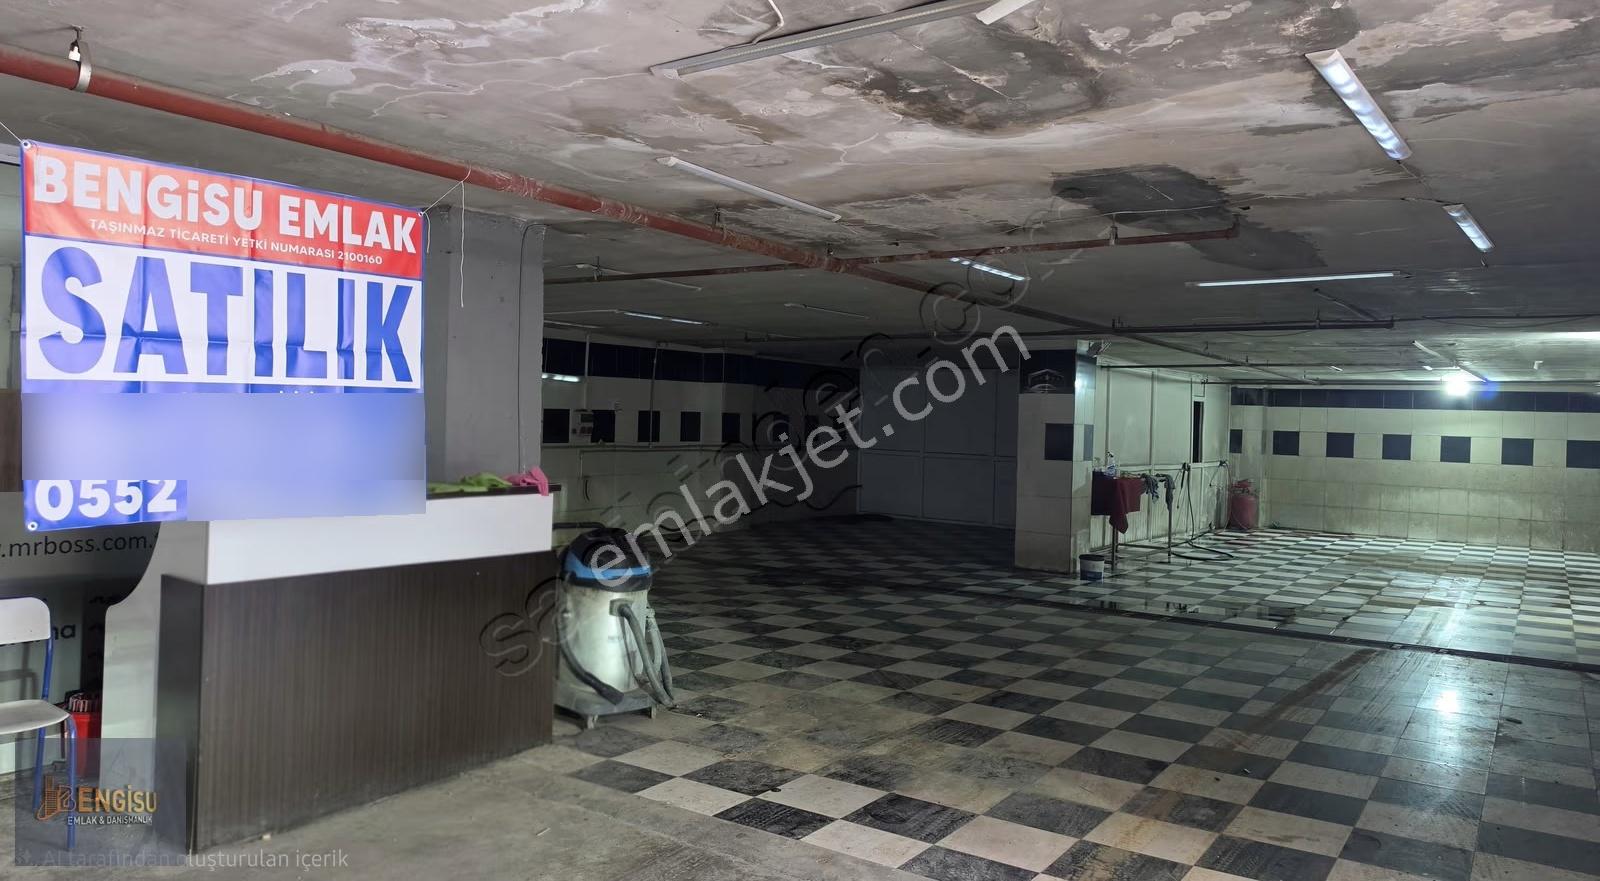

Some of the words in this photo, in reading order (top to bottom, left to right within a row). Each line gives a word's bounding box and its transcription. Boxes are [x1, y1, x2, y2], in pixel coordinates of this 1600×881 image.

[89, 218, 166, 239] TAŞINMAZ
[169, 227, 230, 246] TİCARETİ
[232, 235, 268, 250] YETKİ
[270, 241, 336, 260] NUMARASI
[337, 250, 383, 266] 2100160
[279, 194, 418, 255] EMLAK
[38, 246, 414, 383] SATILIK
[35, 480, 177, 521] 0552
